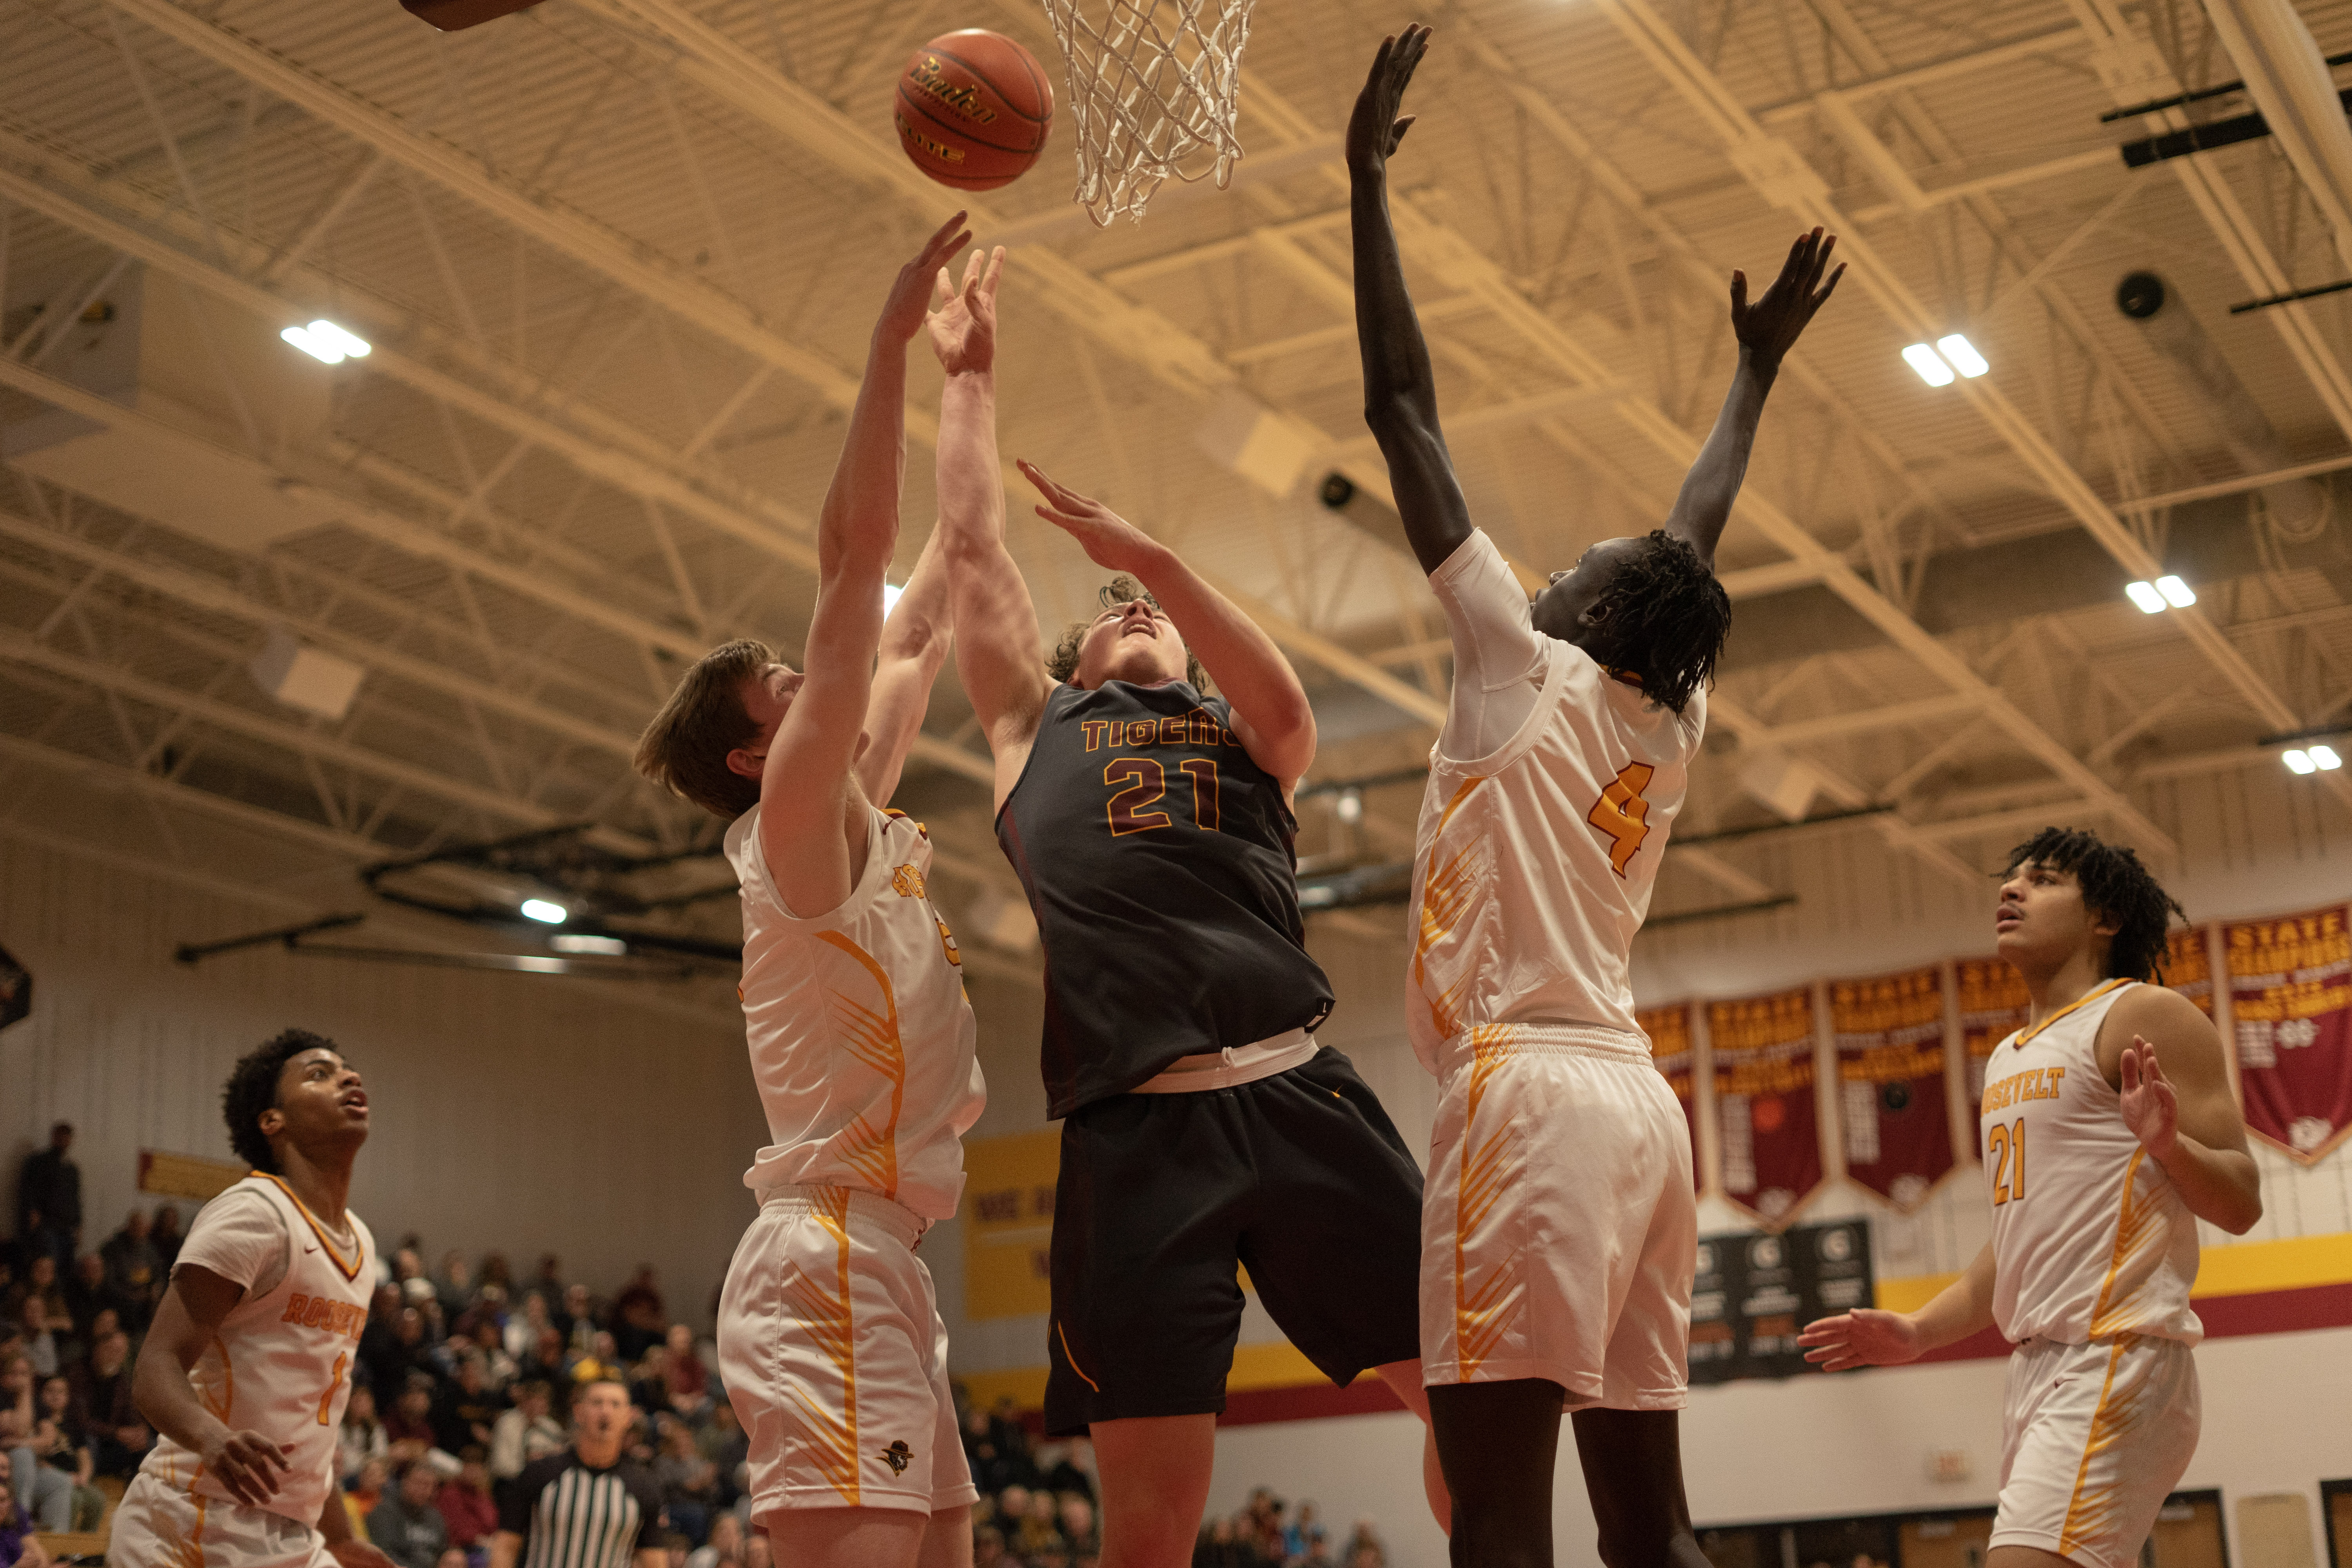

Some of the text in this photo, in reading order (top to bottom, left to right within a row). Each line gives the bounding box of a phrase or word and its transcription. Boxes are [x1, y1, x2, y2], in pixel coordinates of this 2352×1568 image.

[909, 56, 996, 124] Baden
[1103, 758, 1220, 837] 21
[1588, 759, 1655, 880] 4
[1981, 1067, 2065, 1117] OOSEVELT
[1989, 1117, 2025, 1206] 21
[317, 1350, 347, 1426] 1
